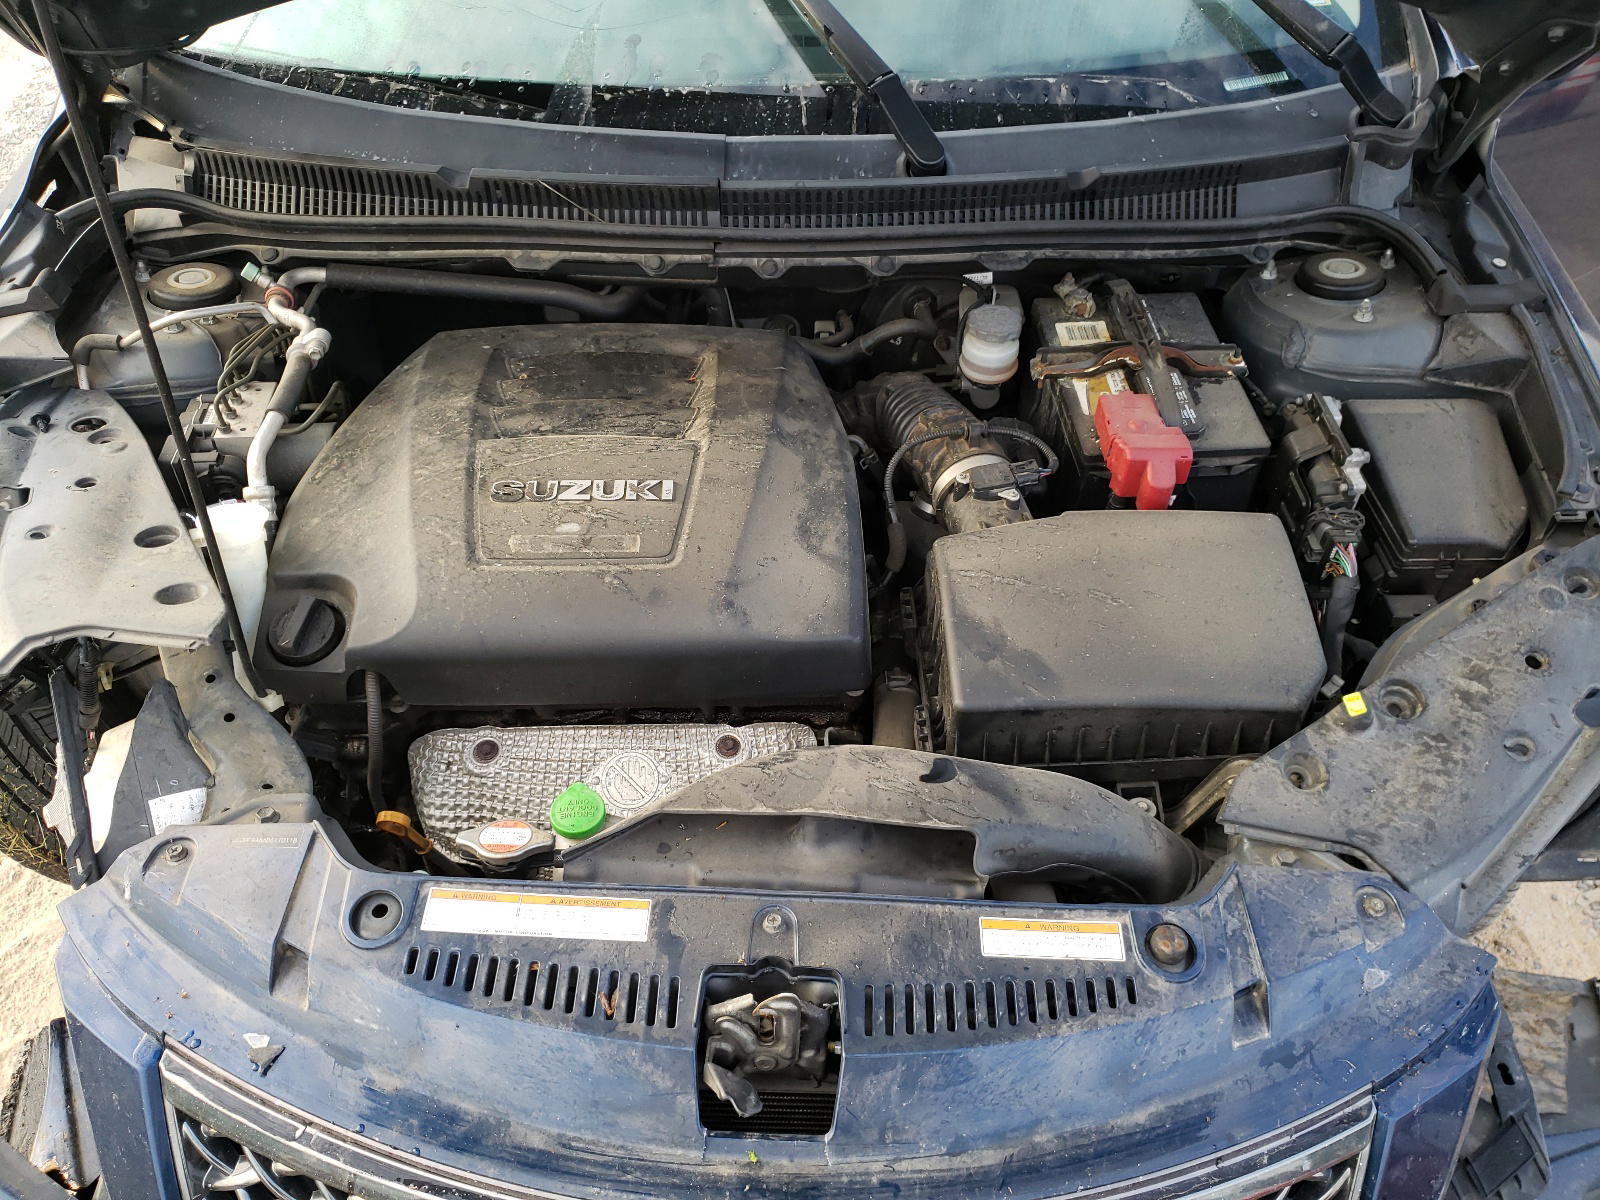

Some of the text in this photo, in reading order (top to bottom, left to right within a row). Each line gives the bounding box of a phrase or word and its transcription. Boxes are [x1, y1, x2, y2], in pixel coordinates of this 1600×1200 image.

[490, 479, 675, 503] SUZUKI
[560, 811, 595, 819] ENGINE
[461, 893, 497, 901] WARNING
[1040, 924, 1080, 932] WARNING
